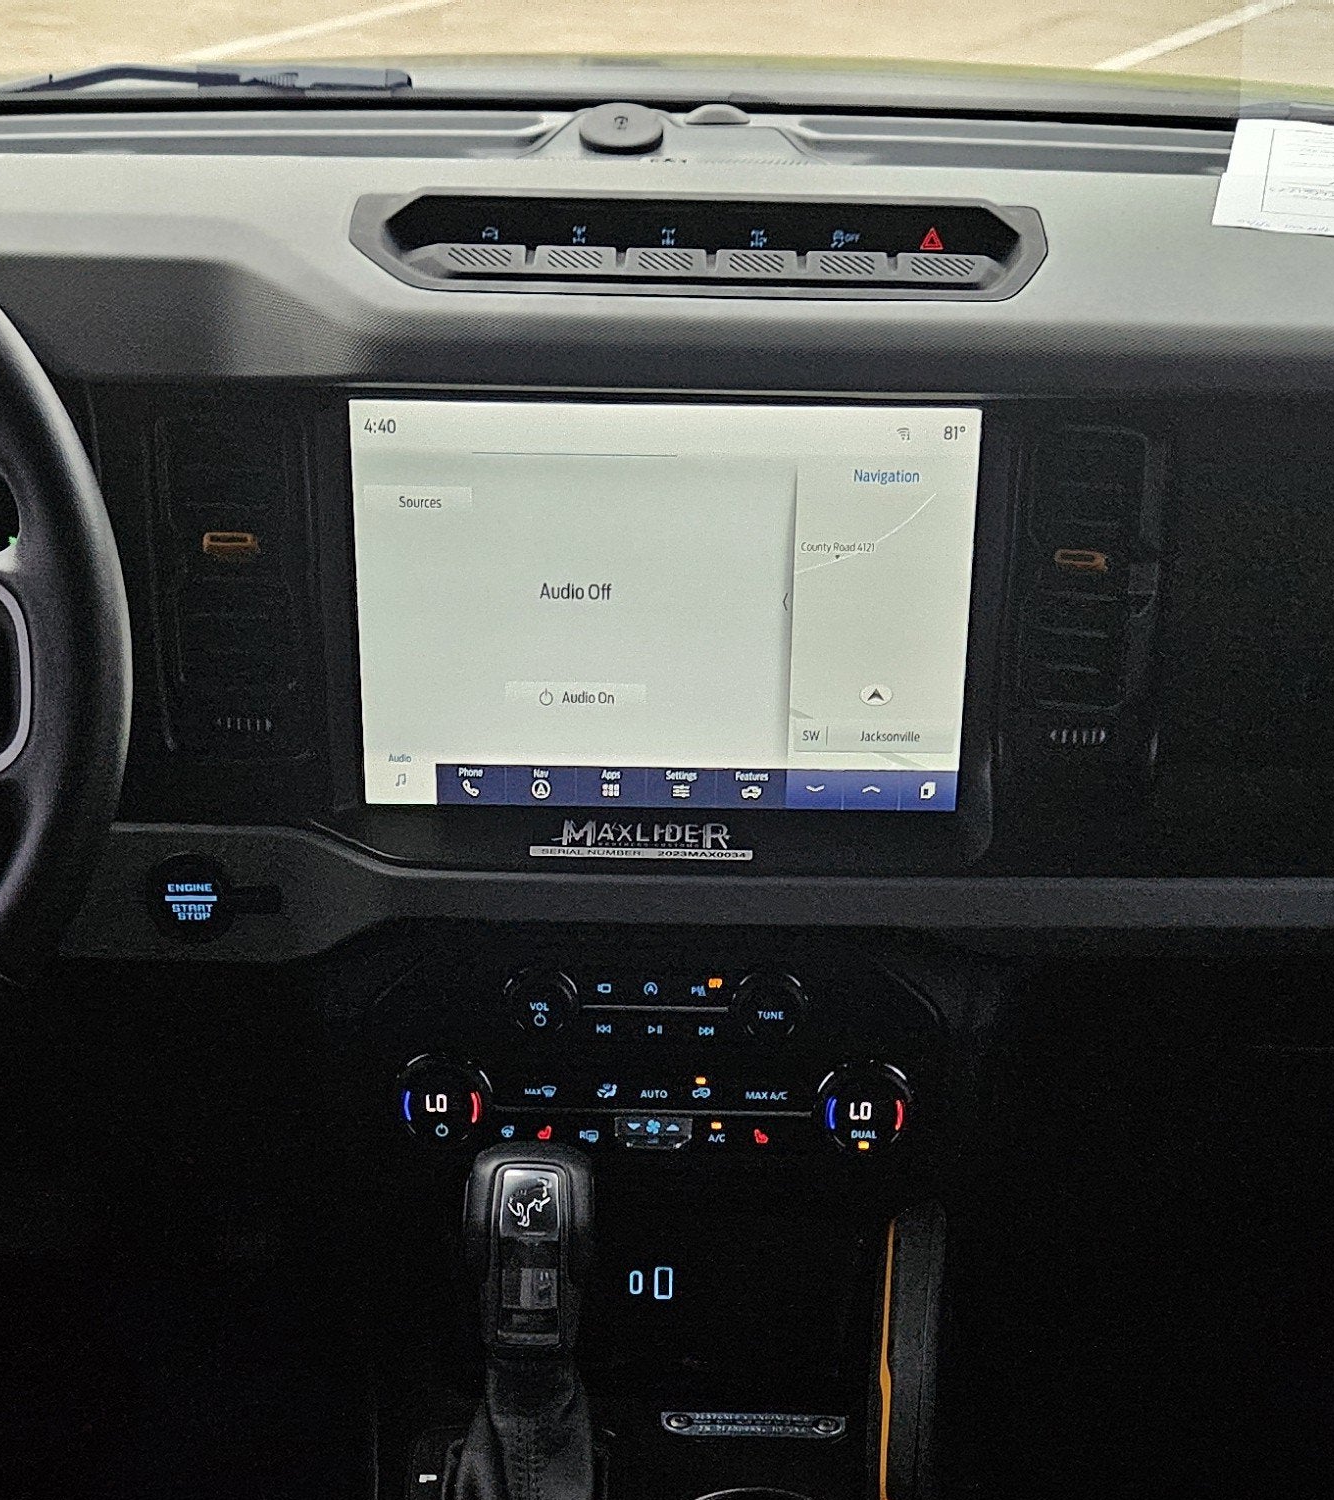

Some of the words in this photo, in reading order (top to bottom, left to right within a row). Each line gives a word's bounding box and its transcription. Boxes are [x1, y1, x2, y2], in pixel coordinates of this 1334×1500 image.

[363, 418, 397, 434] 4:40
[853, 468, 921, 485] Navigation
[398, 495, 442, 509] Sources
[800, 541, 832, 553] County
[833, 541, 856, 553] Road
[539, 582, 585, 601] Audio
[587, 582, 613, 601] Off
[561, 690, 596, 704] Audio
[597, 691, 615, 705] On
[802, 730, 821, 742] SW
[859, 730, 921, 743] Jacksonville
[388, 752, 413, 764] Audio
[457, 766, 484, 779] Phone
[532, 767, 549, 780] Nav
[600, 768, 622, 781] Apps
[664, 769, 698, 782] Settings
[734, 770, 769, 783] Features
[552, 819, 731, 849] MAXLIDER
[541, 848, 585, 856] SERIAL
[167, 883, 213, 893] ENGINE
[171, 903, 214, 913] START
[177, 912, 211, 921] STOP
[529, 1001, 550, 1012] VOL
[757, 1010, 785, 1021] TUNE
[524, 1087, 542, 1096] MAX
[640, 1089, 668, 1099] AUTO
[745, 1090, 768, 1100] MAX
[769, 1091, 789, 1101] A/C
[425, 1093, 448, 1113] LO
[849, 1101, 873, 1121] LO
[708, 1133, 726, 1143] A/C
[850, 1129, 878, 1139] DUAL
[419, 1474, 437, 1483] P
